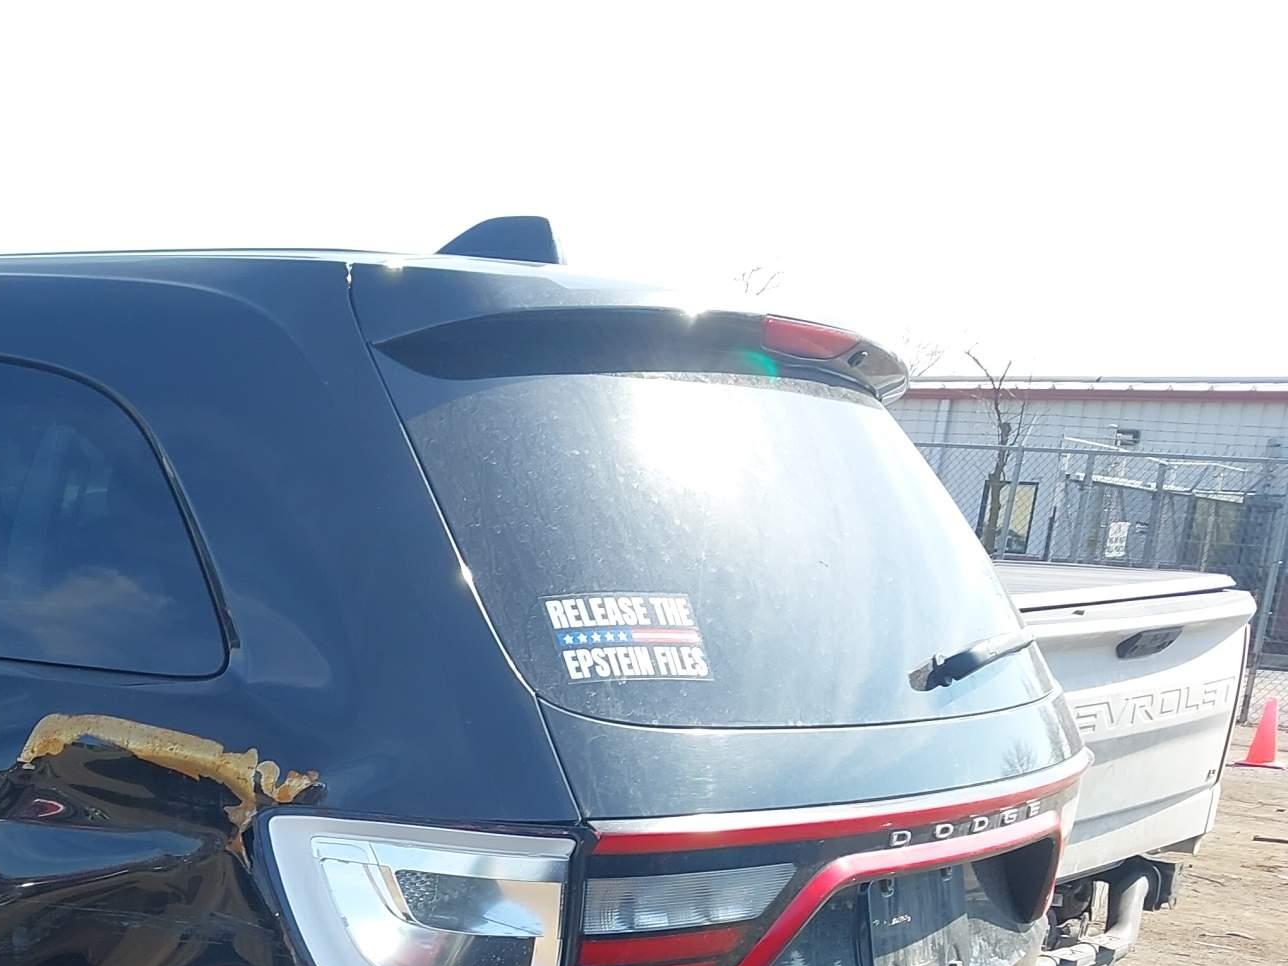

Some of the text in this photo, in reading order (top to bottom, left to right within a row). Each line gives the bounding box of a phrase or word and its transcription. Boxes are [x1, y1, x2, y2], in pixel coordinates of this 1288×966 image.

[545, 597, 695, 629] RELEASE THE
[563, 646, 710, 679] EPSTEIN FILES
[1073, 675, 1236, 734] EVROLET
[890, 799, 1042, 847] DODGE
